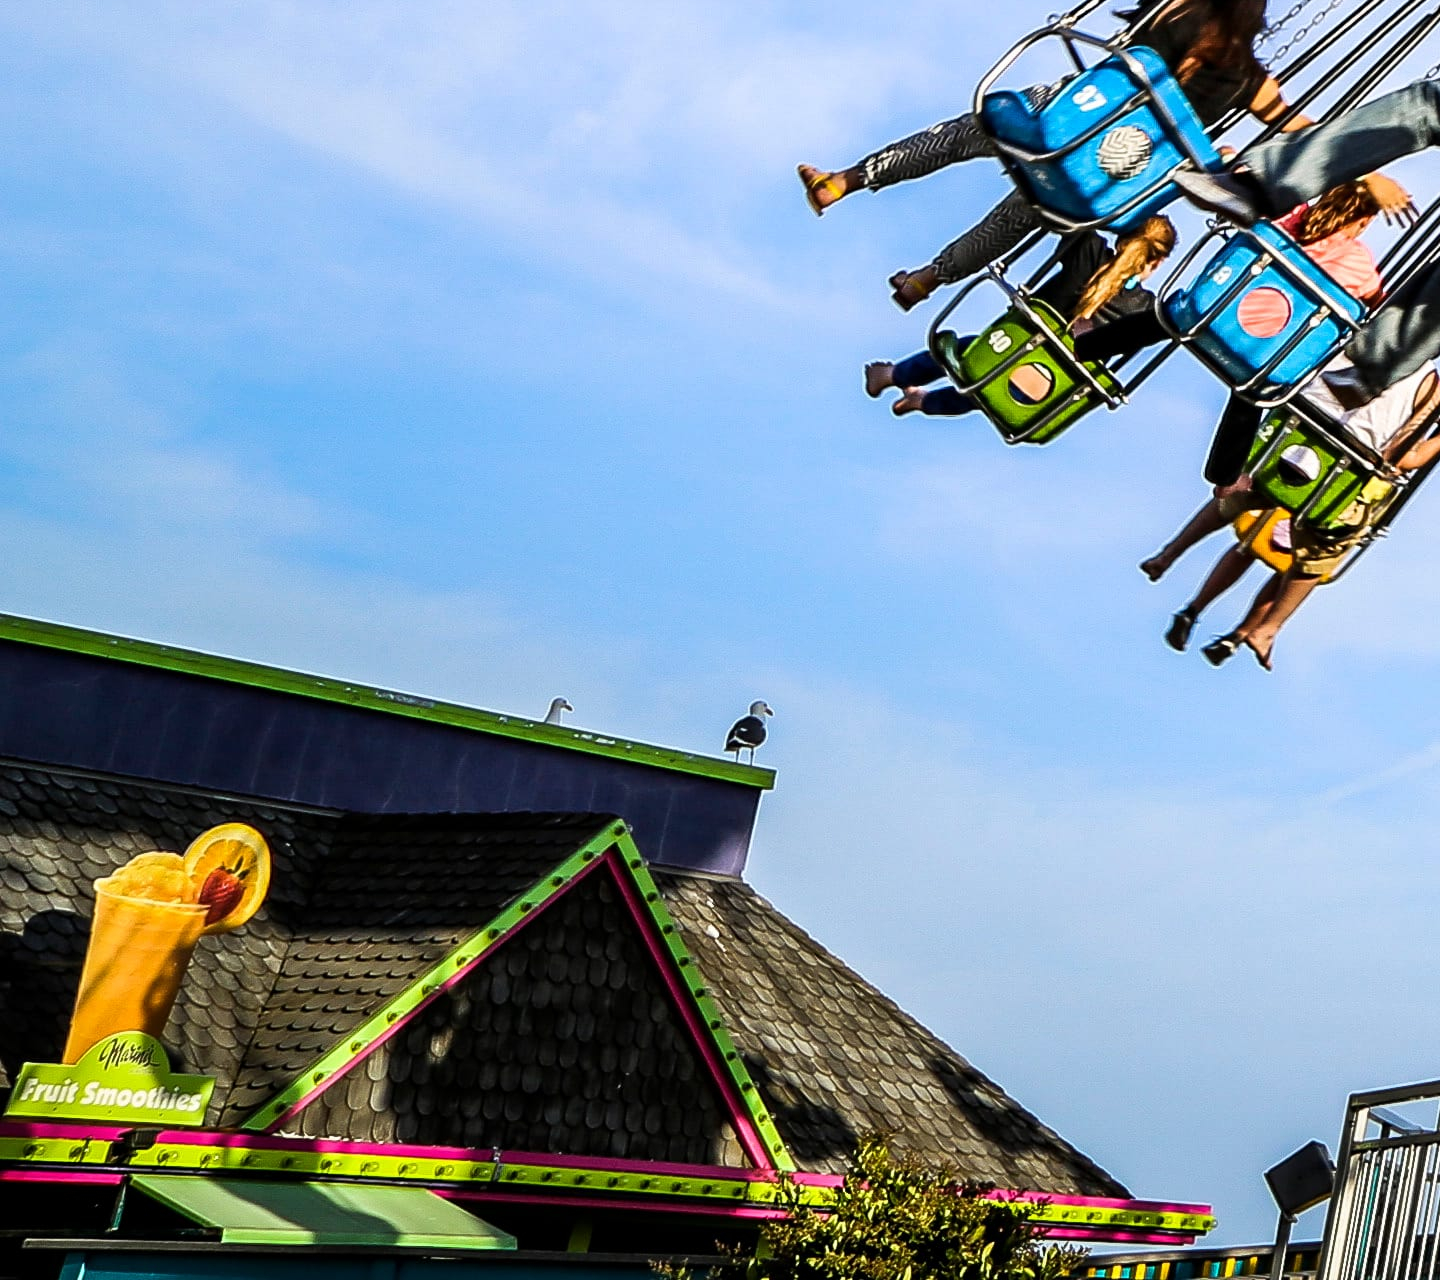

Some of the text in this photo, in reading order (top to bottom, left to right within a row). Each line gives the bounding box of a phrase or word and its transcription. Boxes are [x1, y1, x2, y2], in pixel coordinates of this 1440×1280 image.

[989, 329, 1012, 353] 40
[20, 1077, 202, 1112] Fruit Smoothies
